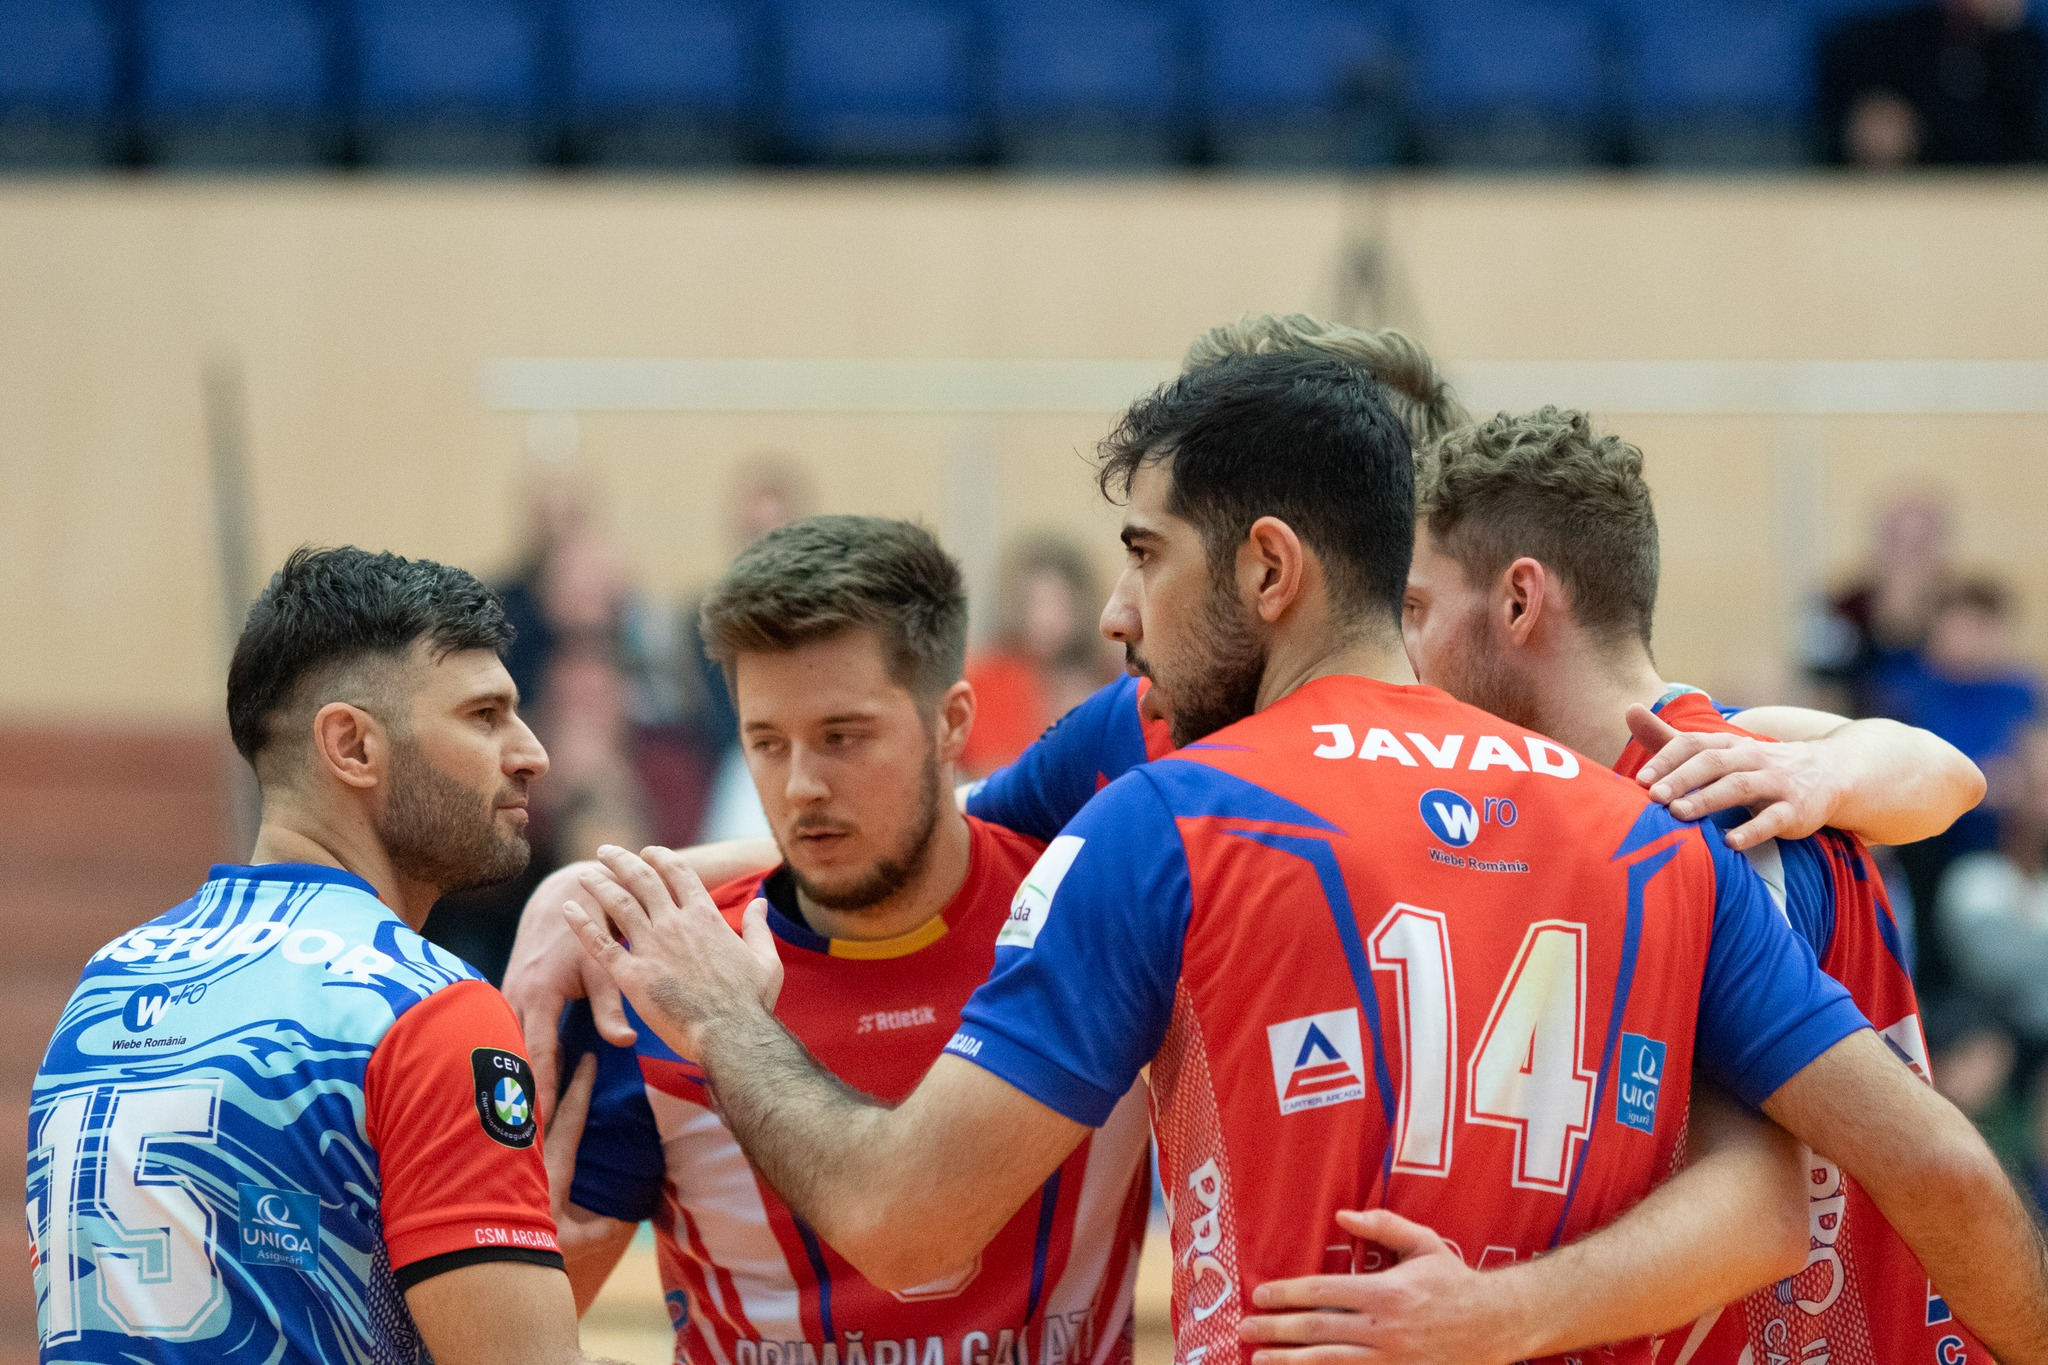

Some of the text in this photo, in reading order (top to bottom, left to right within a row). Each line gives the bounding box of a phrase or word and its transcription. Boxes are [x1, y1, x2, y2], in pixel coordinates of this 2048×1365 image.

[1311, 723, 1580, 779] JAVAD
[1429, 849, 1529, 873] Wiebe România
[112, 1036, 187, 1050] Wiebe România
[1368, 902, 1597, 1194] 14
[493, 1056, 520, 1073] CEV
[37, 1078, 223, 1348] 15
[243, 1227, 314, 1254] UNIQA
[475, 1228, 557, 1249] CSM ARCADA
